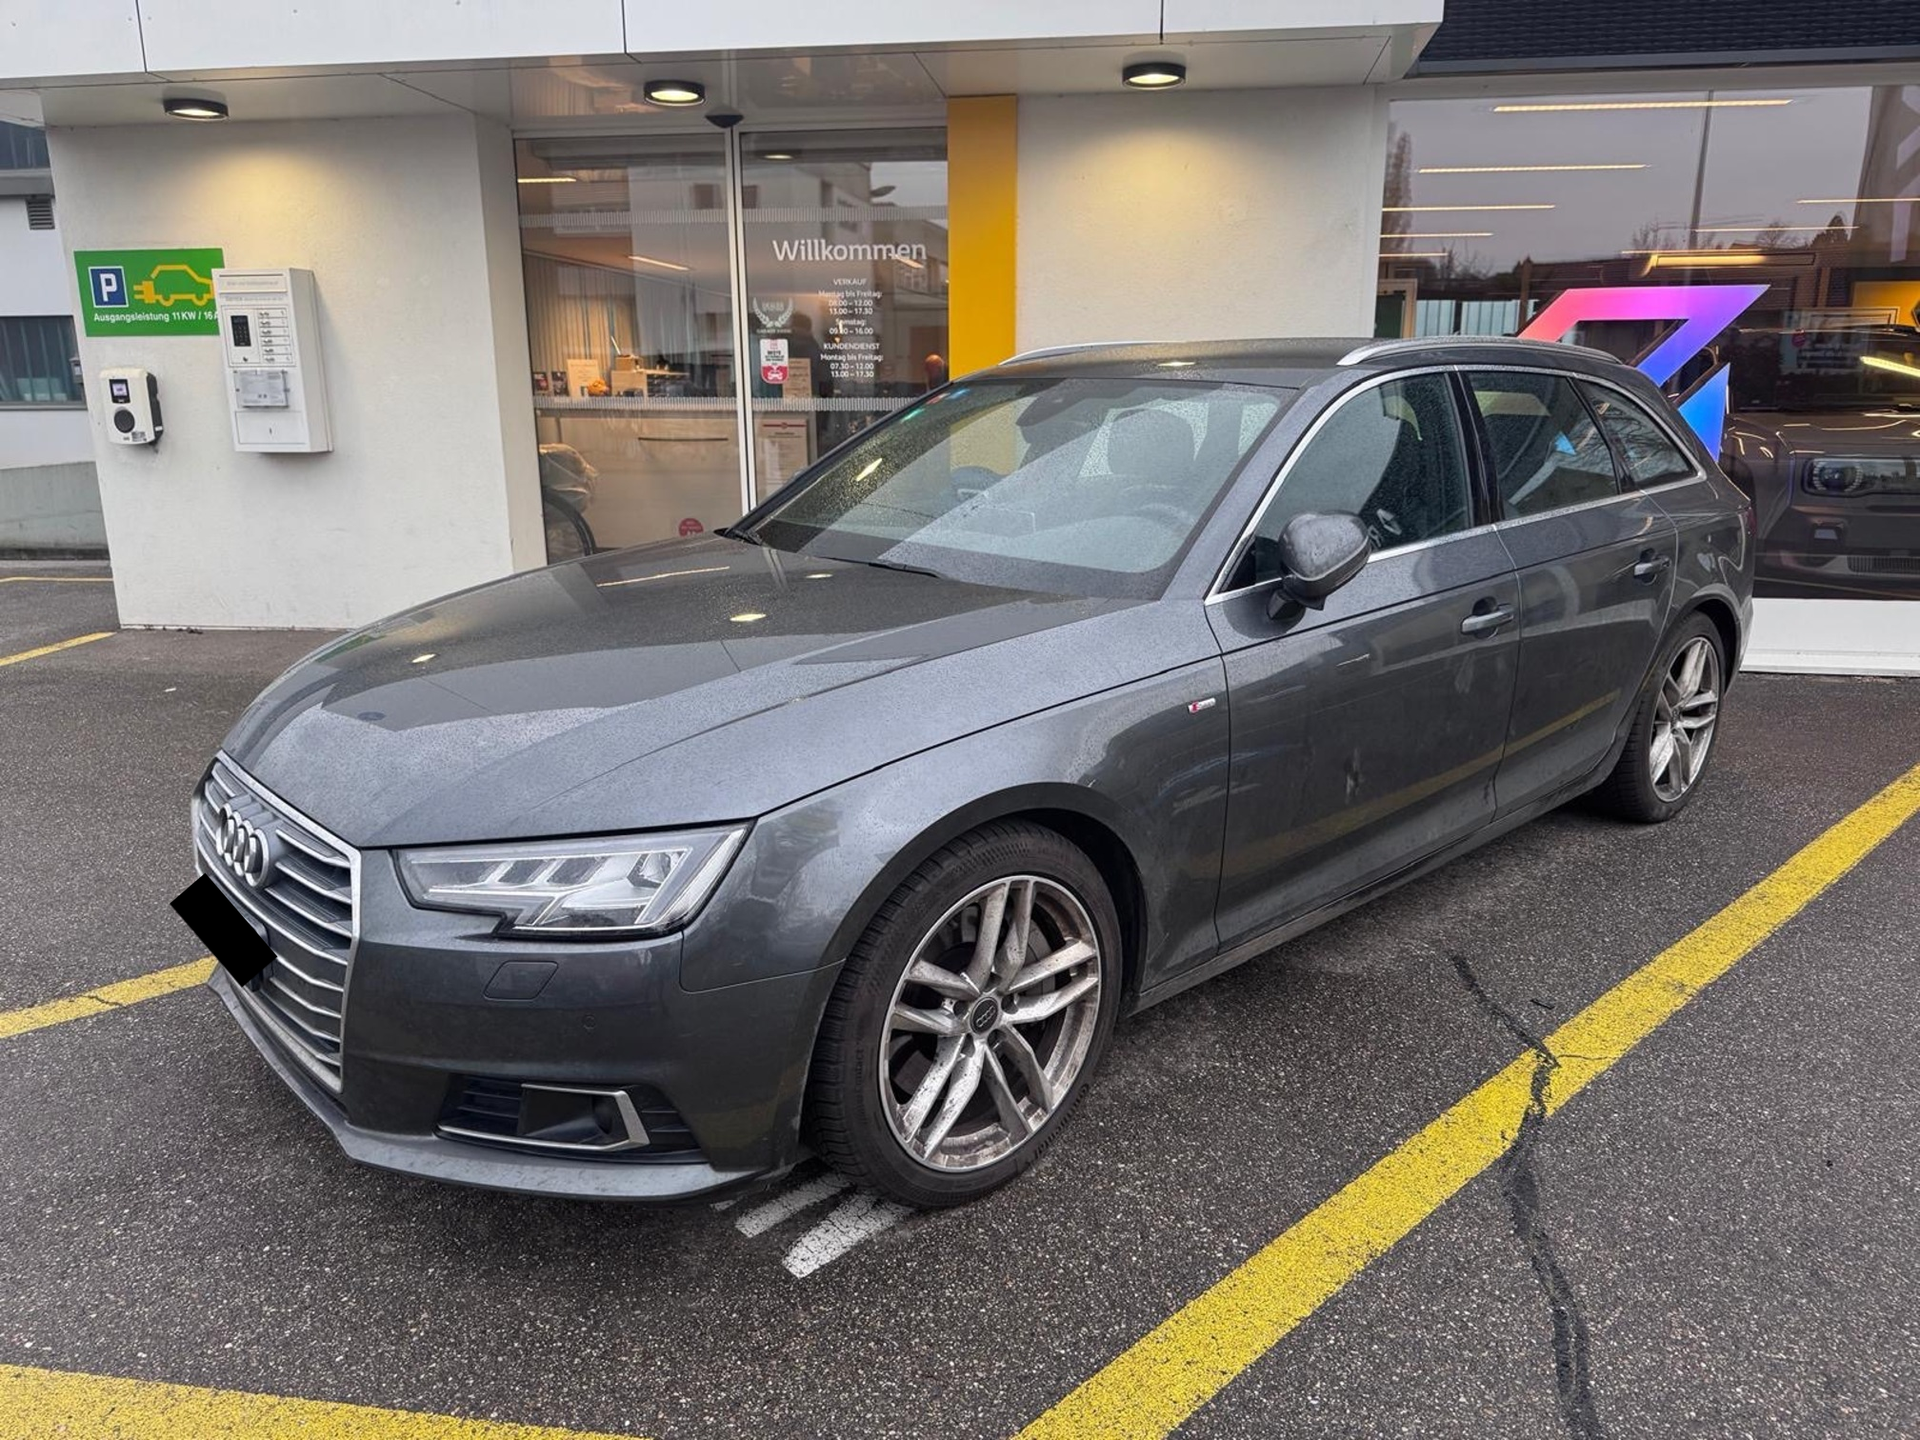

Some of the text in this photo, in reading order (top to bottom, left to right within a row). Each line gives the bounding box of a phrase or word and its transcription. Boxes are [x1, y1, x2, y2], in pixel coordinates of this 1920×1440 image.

[772, 239, 927, 261] Willkommen
[833, 278, 867, 286] VERKAUF
[100, 273, 117, 302] P
[829, 307, 848, 315] 13.00
[854, 307, 873, 315] 17.30
[94, 312, 170, 323] Ausgangsleistung
[823, 342, 880, 350] KUNDENDIENST
[820, 353, 884, 362] Montag bis Freitag:
[830, 362, 849, 370] 07.30
[855, 362, 875, 370] 12.00
[831, 370, 849, 378] 13.00
[855, 370, 875, 378] 17.30
